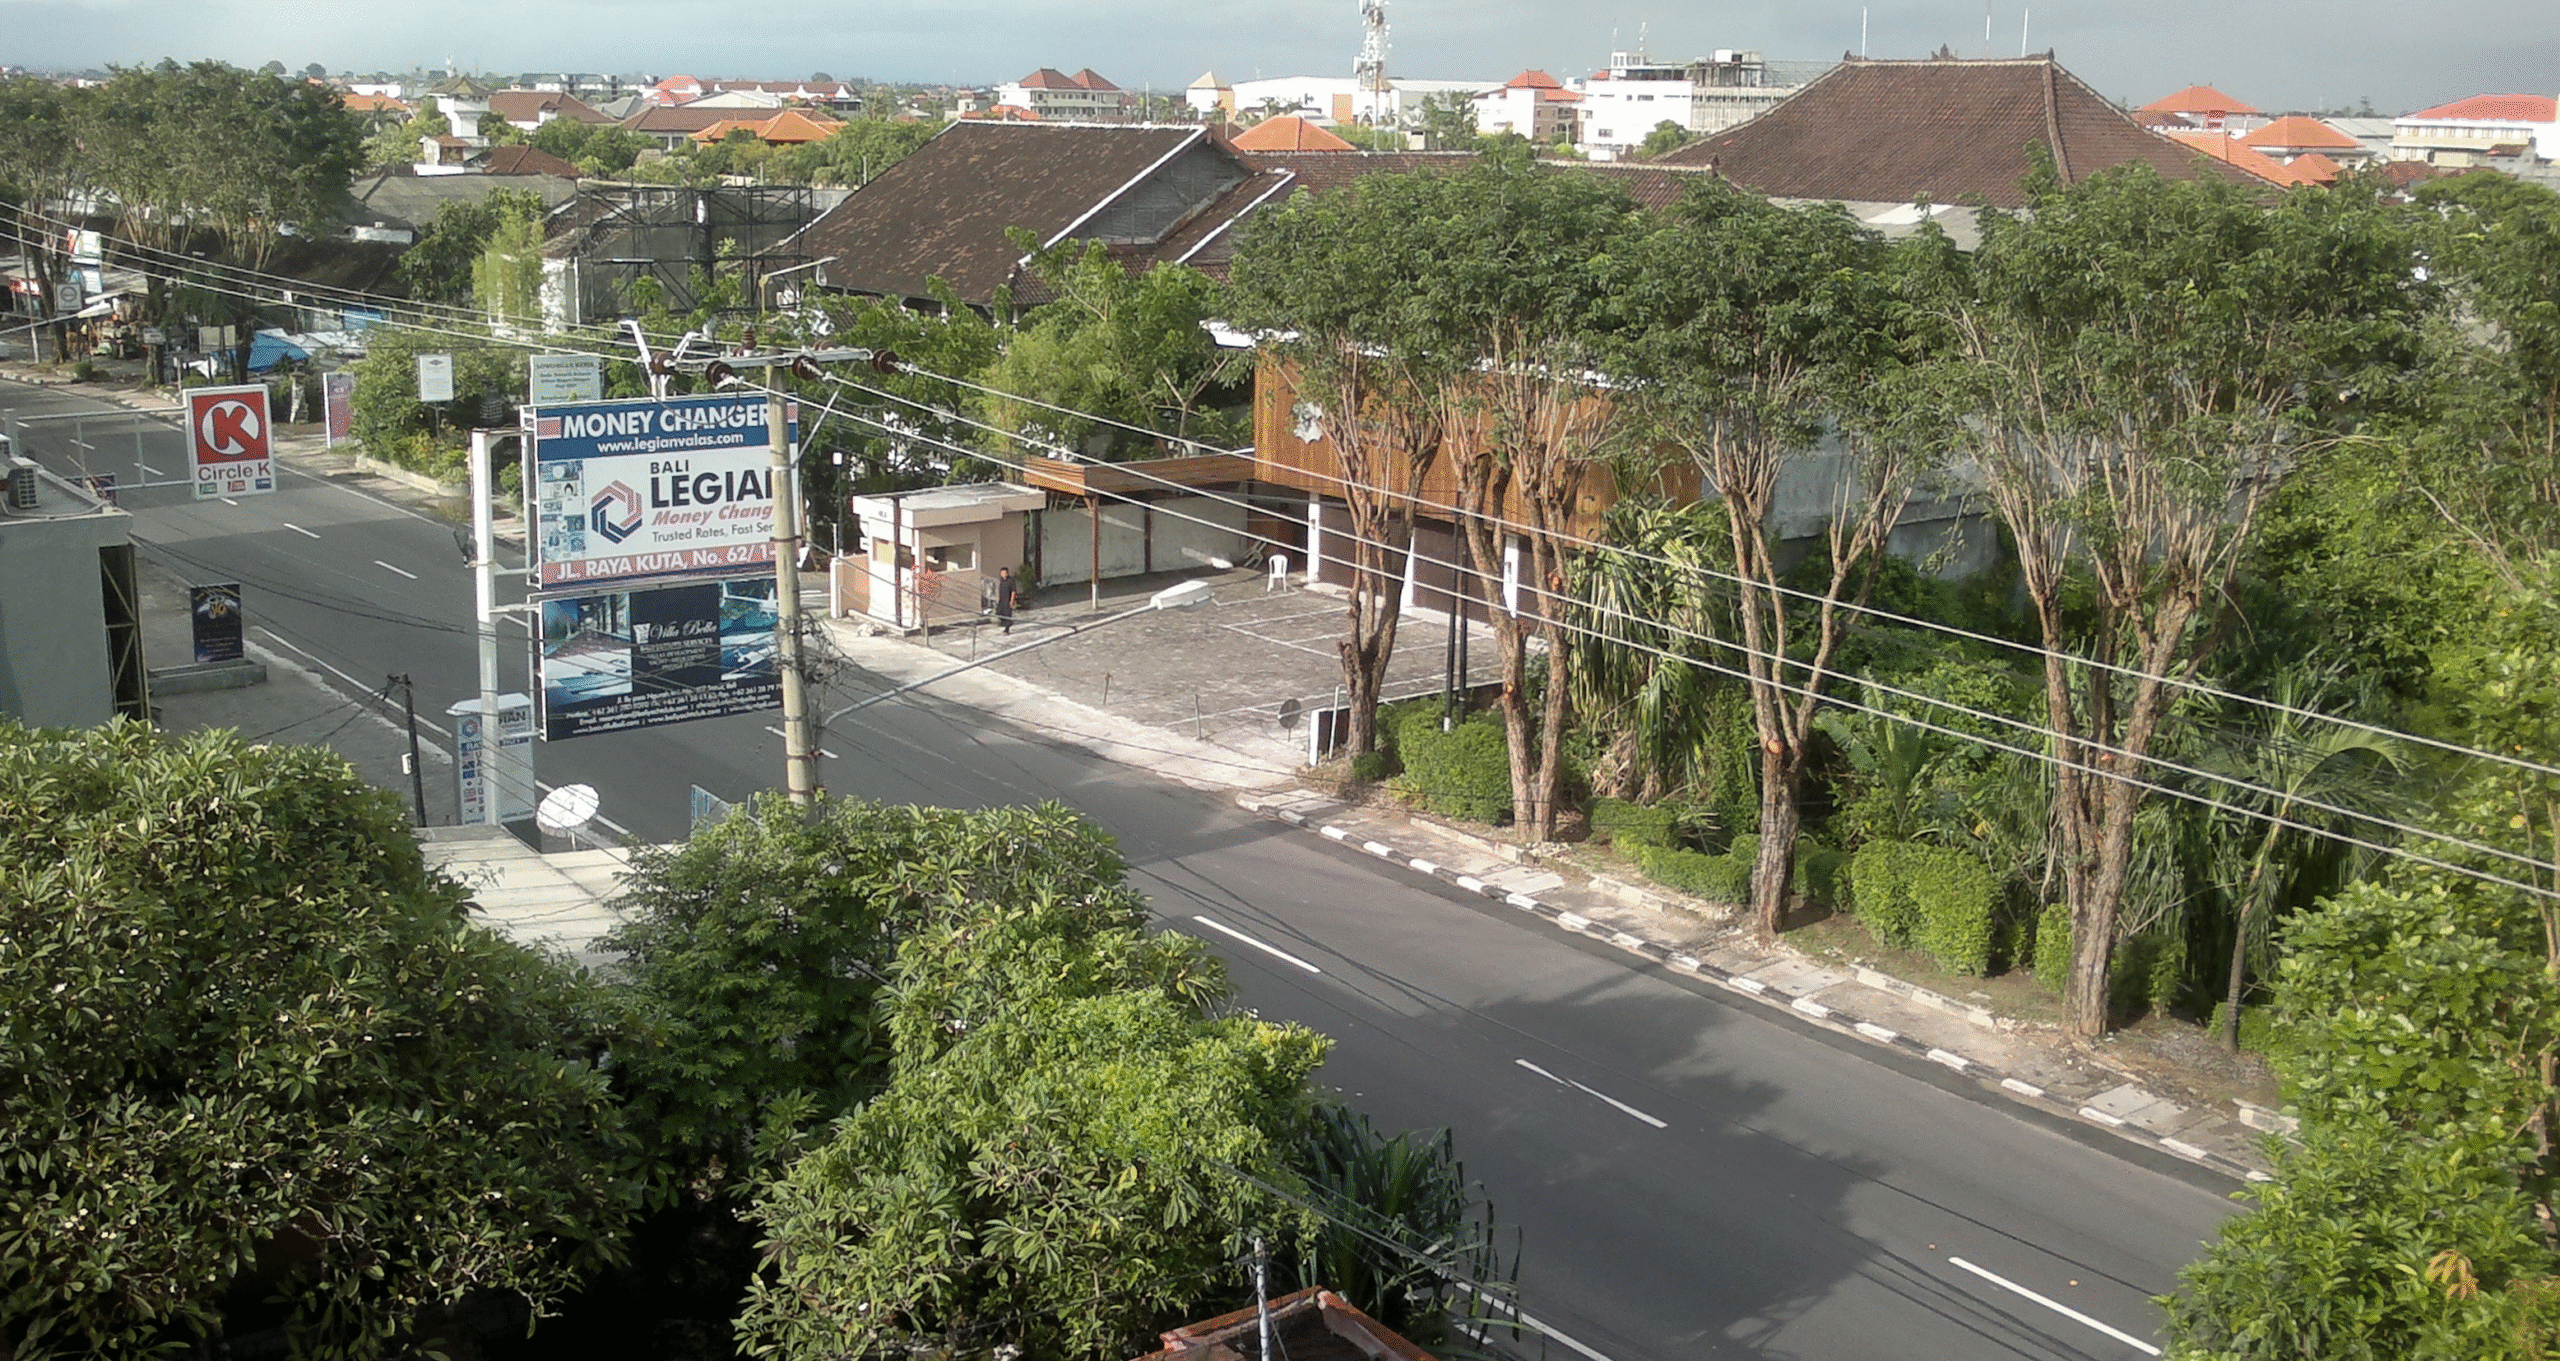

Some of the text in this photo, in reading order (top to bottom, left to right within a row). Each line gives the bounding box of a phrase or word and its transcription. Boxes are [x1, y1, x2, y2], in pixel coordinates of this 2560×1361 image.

[563, 404, 769, 438] MONEY CHANGER
[597, 432, 744, 452] www.legianvalas.com
[198, 461, 271, 481] Circle K
[650, 459, 689, 474] BALI
[651, 510, 713, 526] Money
[652, 528, 692, 542] Trusted
[696, 527, 728, 538] Rates,
[731, 523, 753, 535] Fast
[585, 558, 632, 578] RAYA
[636, 551, 688, 572] KUTA,
[693, 550, 722, 566] No.
